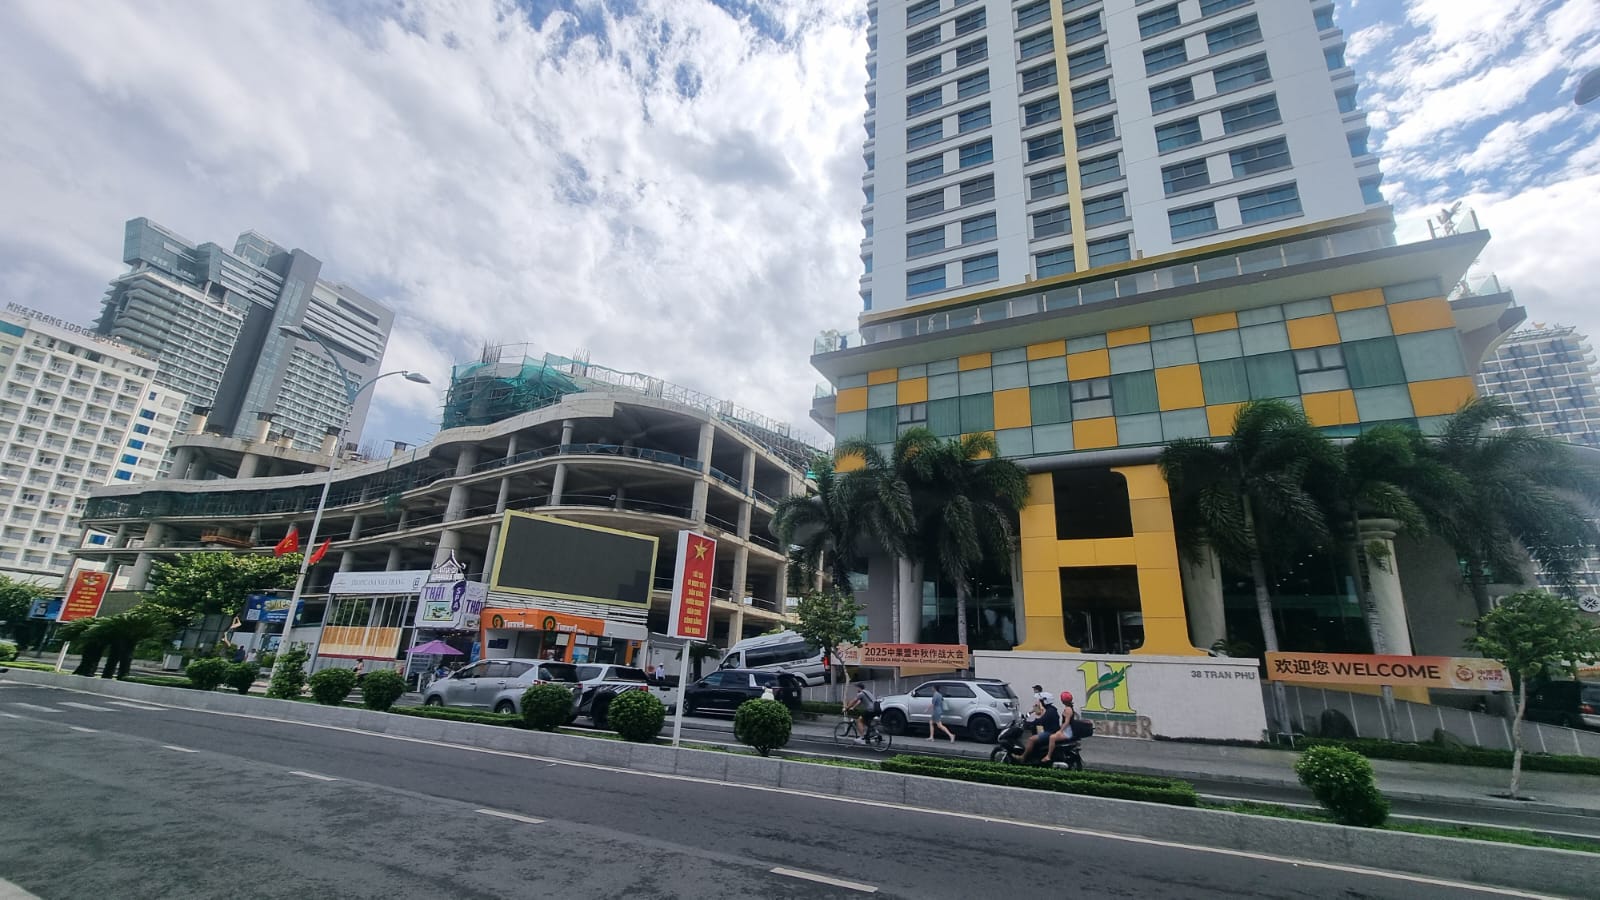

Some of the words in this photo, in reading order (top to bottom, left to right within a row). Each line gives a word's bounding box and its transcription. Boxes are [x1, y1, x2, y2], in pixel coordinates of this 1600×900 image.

[6, 301, 29, 316] NHA
[29, 310, 62, 328] TRANG
[64, 321, 94, 337] LODGE
[454, 587, 462, 608] SPA
[1191, 670, 1202, 678] 38
[1205, 670, 1232, 679] TRAN
[1234, 671, 1256, 680] PHU
[1275, 659, 1330, 675] 欢迎您
[1332, 662, 1441, 680] WELCOME
